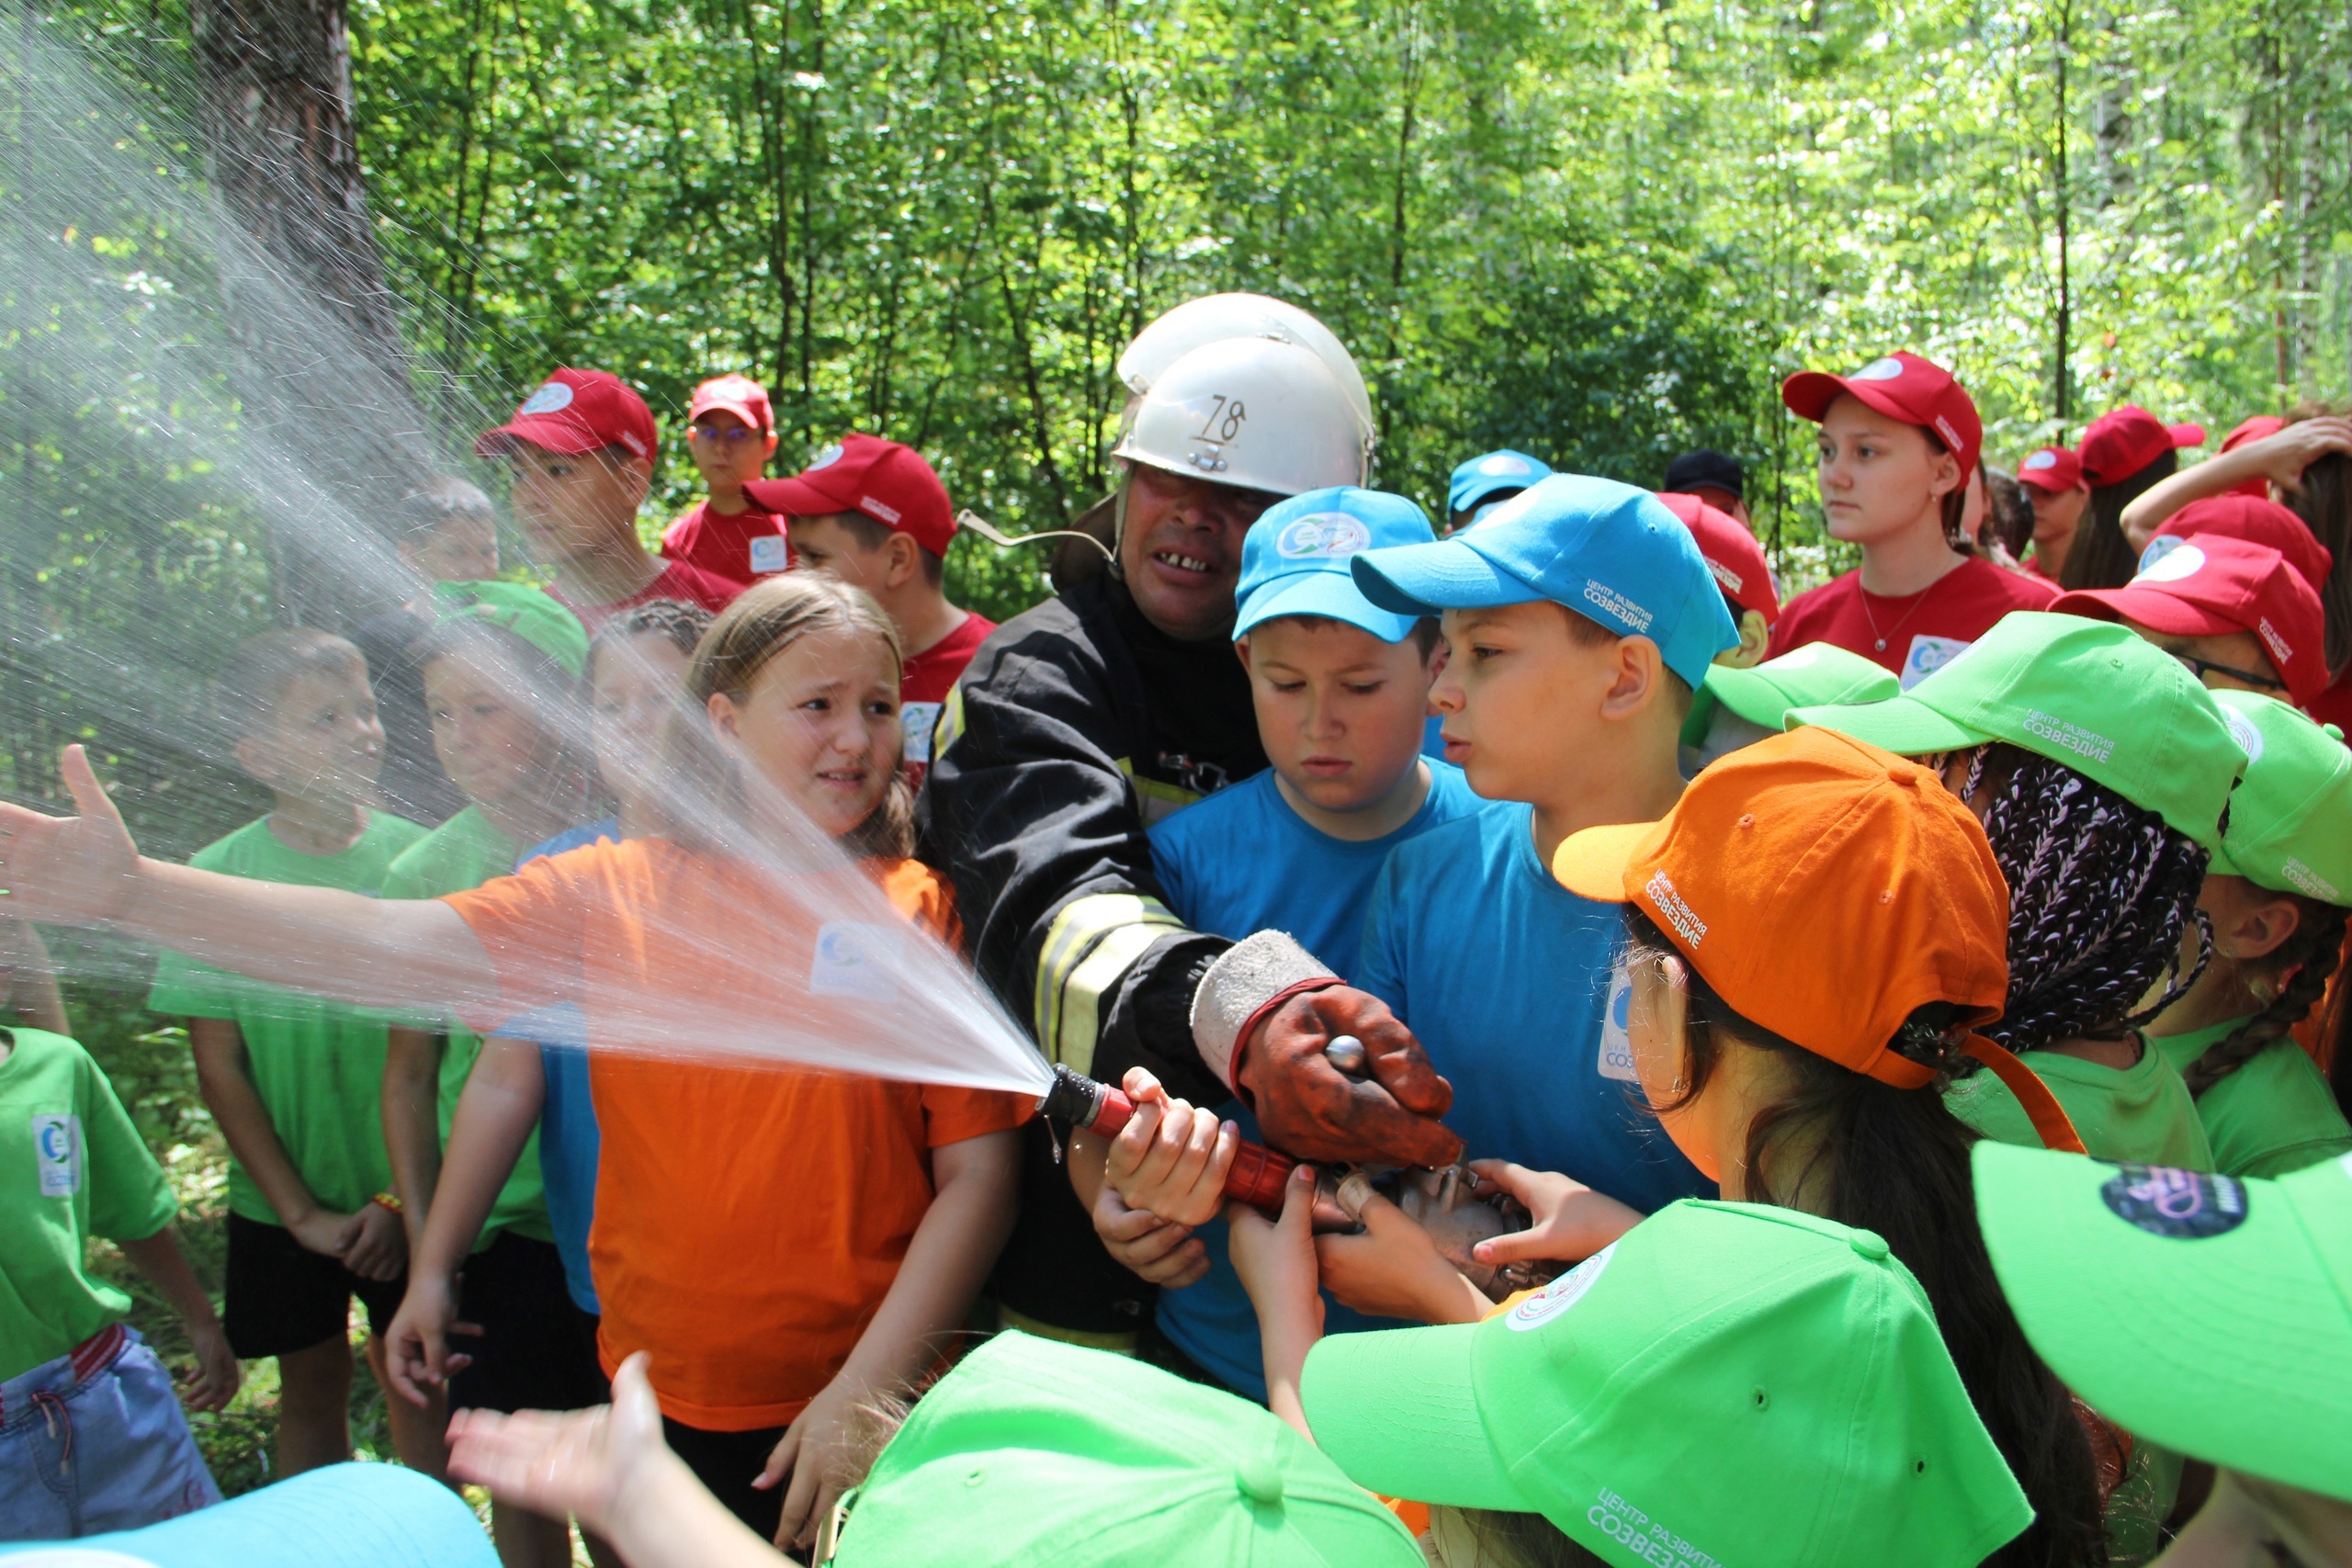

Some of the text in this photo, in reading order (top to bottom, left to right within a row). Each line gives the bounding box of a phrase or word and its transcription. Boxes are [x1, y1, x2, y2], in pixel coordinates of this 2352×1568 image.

[1583, 588, 1649, 634] СОЗВЕЗДИЕ
[1587, 578, 1653, 623] ЦЕНТР РАЗВИТИЯ
[2022, 718, 2110, 764] СОЗВЕЗДИЕ
[2028, 708, 2115, 750] ЦЕНТР РАЗВИТИЯ
[1645, 879, 1702, 951] СОЗВЕЗДИЕ
[1655, 868, 1708, 936] ЦЕНТР РАЗВИТИЯ
[1597, 1486, 1649, 1526] ЦЕНТР
